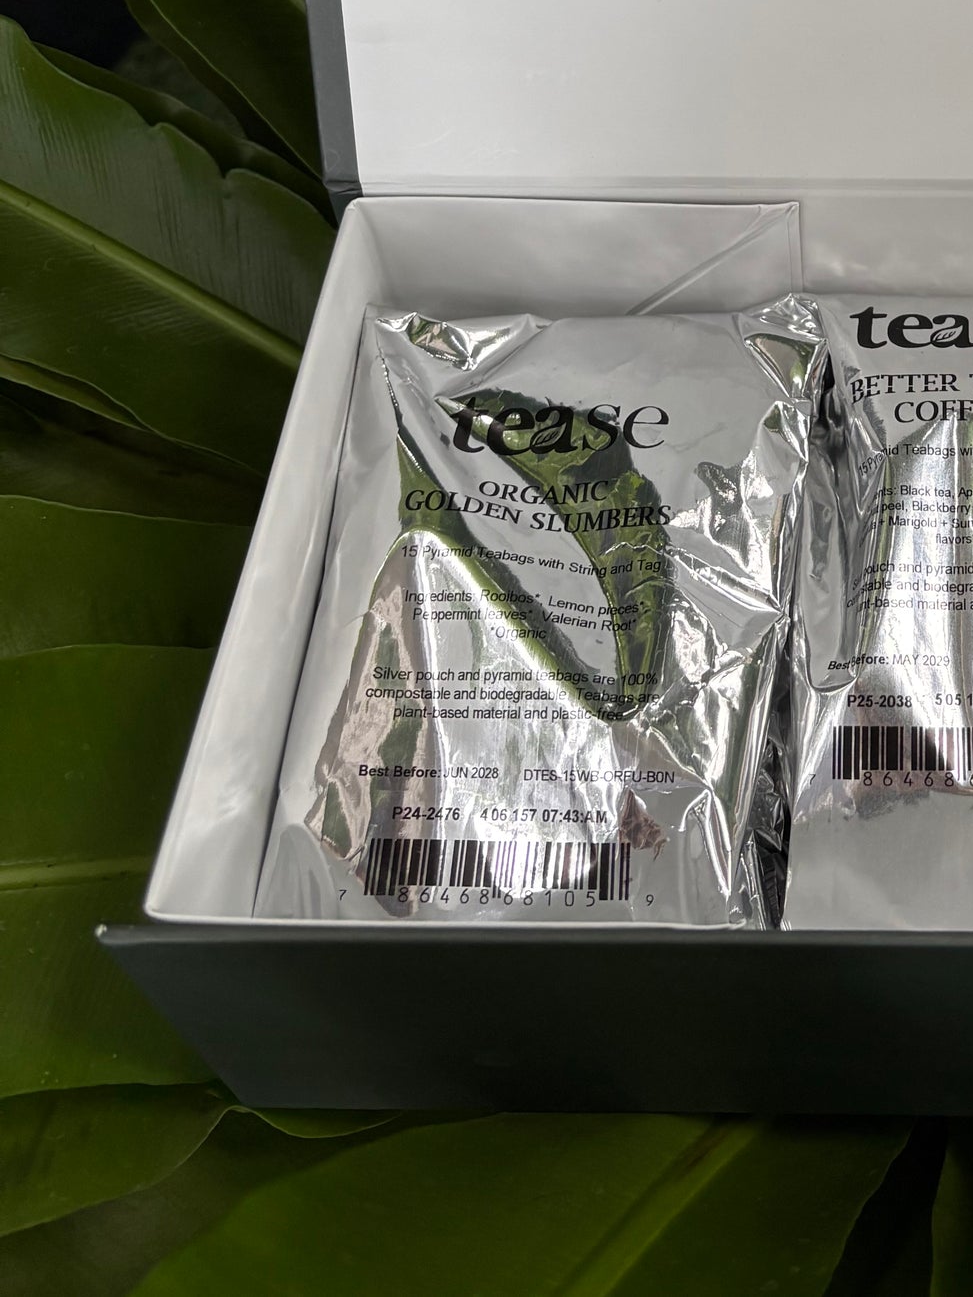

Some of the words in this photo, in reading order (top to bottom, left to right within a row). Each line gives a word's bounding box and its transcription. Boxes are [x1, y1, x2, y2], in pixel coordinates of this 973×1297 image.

[851, 373, 960, 404] BETTER
[451, 395, 670, 456] tease
[903, 443, 956, 460] Teabags
[478, 479, 610, 505] ORGANIC
[900, 484, 931, 497] Black
[405, 488, 523, 525] GOLDEN
[530, 504, 673, 534] SLUMBERS
[912, 501, 971, 516] Blackberry
[888, 515, 937, 531] Marigold
[401, 545, 418, 558] 15
[422, 545, 473, 561] Pyramid
[477, 546, 535, 566] Teabags
[538, 557, 565, 571] with
[568, 562, 607, 579] String
[610, 560, 634, 575] and
[637, 558, 662, 573] Tag
[898, 561, 922, 574] and
[896, 579, 920, 592] and
[548, 595, 595, 614] Lemon
[917, 596, 967, 611] material
[412, 607, 481, 624] Peppermint
[541, 610, 598, 631] Valerian
[827, 659, 850, 671] Best
[892, 653, 919, 665] MAY
[922, 654, 950, 667] 2029
[372, 666, 413, 682] Silver
[415, 668, 455, 685] pouch
[457, 668, 480, 682] and
[483, 668, 533, 685] pyramid
[536, 669, 589, 686] teabags
[592, 674, 616, 686] are
[620, 672, 658, 687] 100%
[365, 687, 451, 704] compostable
[453, 687, 477, 702] and
[576, 688, 635, 707] Teabags
[637, 692, 660, 704] are
[847, 694, 913, 708] P25-2038
[393, 705, 470, 721] plant-based
[472, 705, 521, 720] material
[523, 706, 548, 720] and
[358, 764, 389, 779] Best
[392, 765, 442, 780] Before:
[443, 766, 470, 780] JUN
[471, 766, 500, 780] 2028
[392, 807, 461, 822] P24-2476
[512, 807, 537, 823] 157
